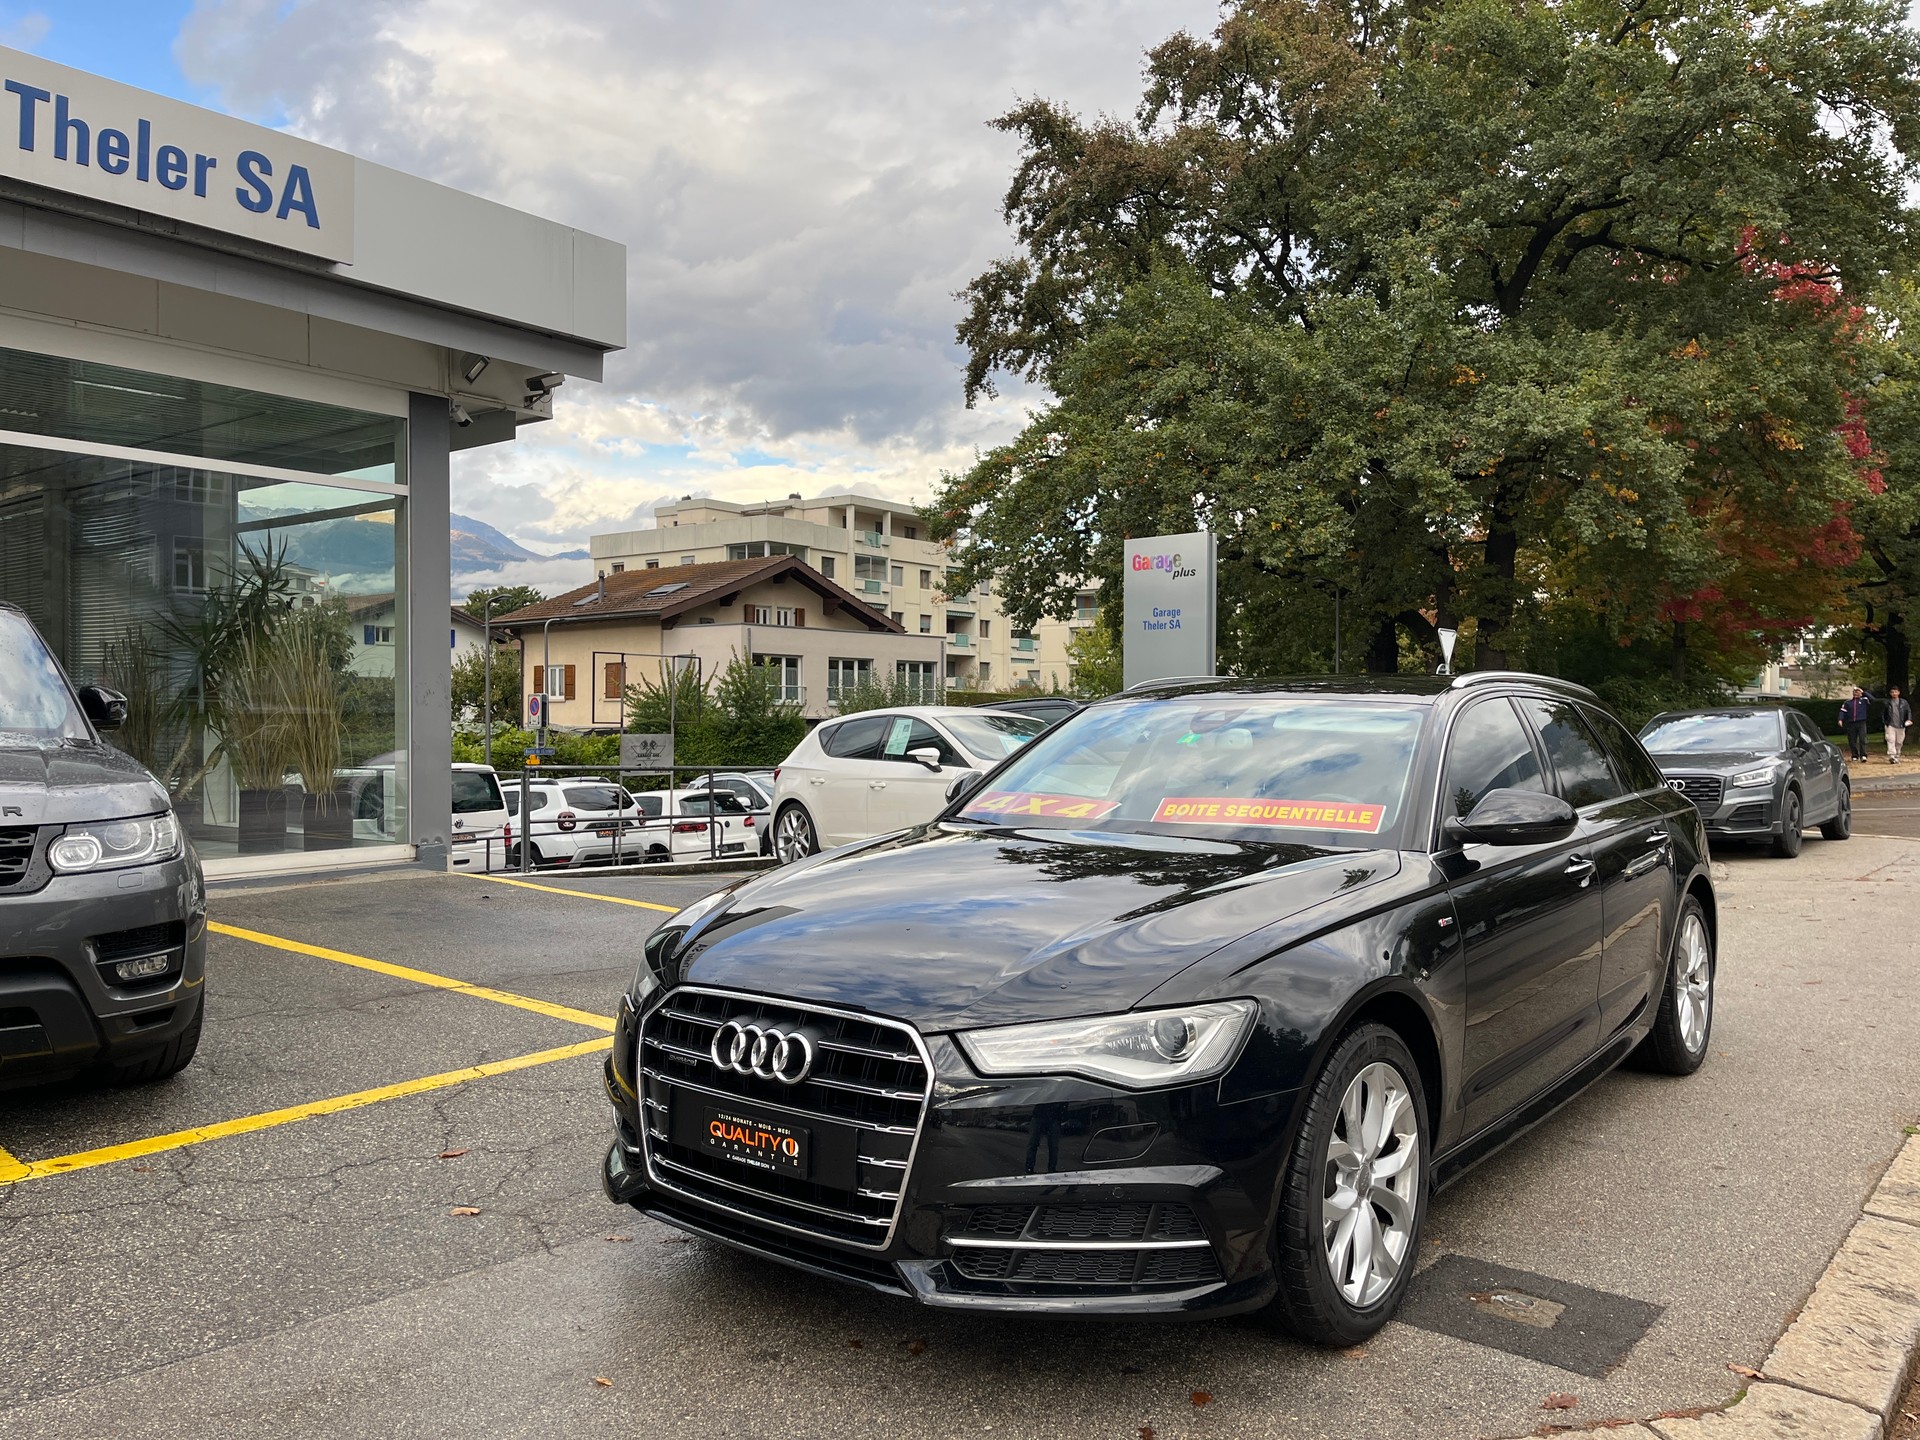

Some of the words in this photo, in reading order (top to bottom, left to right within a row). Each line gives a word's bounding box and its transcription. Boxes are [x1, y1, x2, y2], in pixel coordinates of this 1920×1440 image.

[5, 79, 217, 198] Theler
[235, 150, 320, 229] SA
[1132, 553, 1182, 573] Garage
[1172, 567, 1196, 580] plus
[1152, 607, 1181, 618] Garage
[1142, 620, 1167, 630] Theler
[1169, 619, 1181, 629] SA
[1163, 804, 1220, 817] BOITE
[1223, 804, 1374, 825] SEQUENTIELLE
[718, 1113, 731, 1121] 12/24
[758, 1122, 771, 1131] MOIS
[709, 1120, 781, 1151] QUALITY
[710, 1138, 798, 1166] GARANTIE
